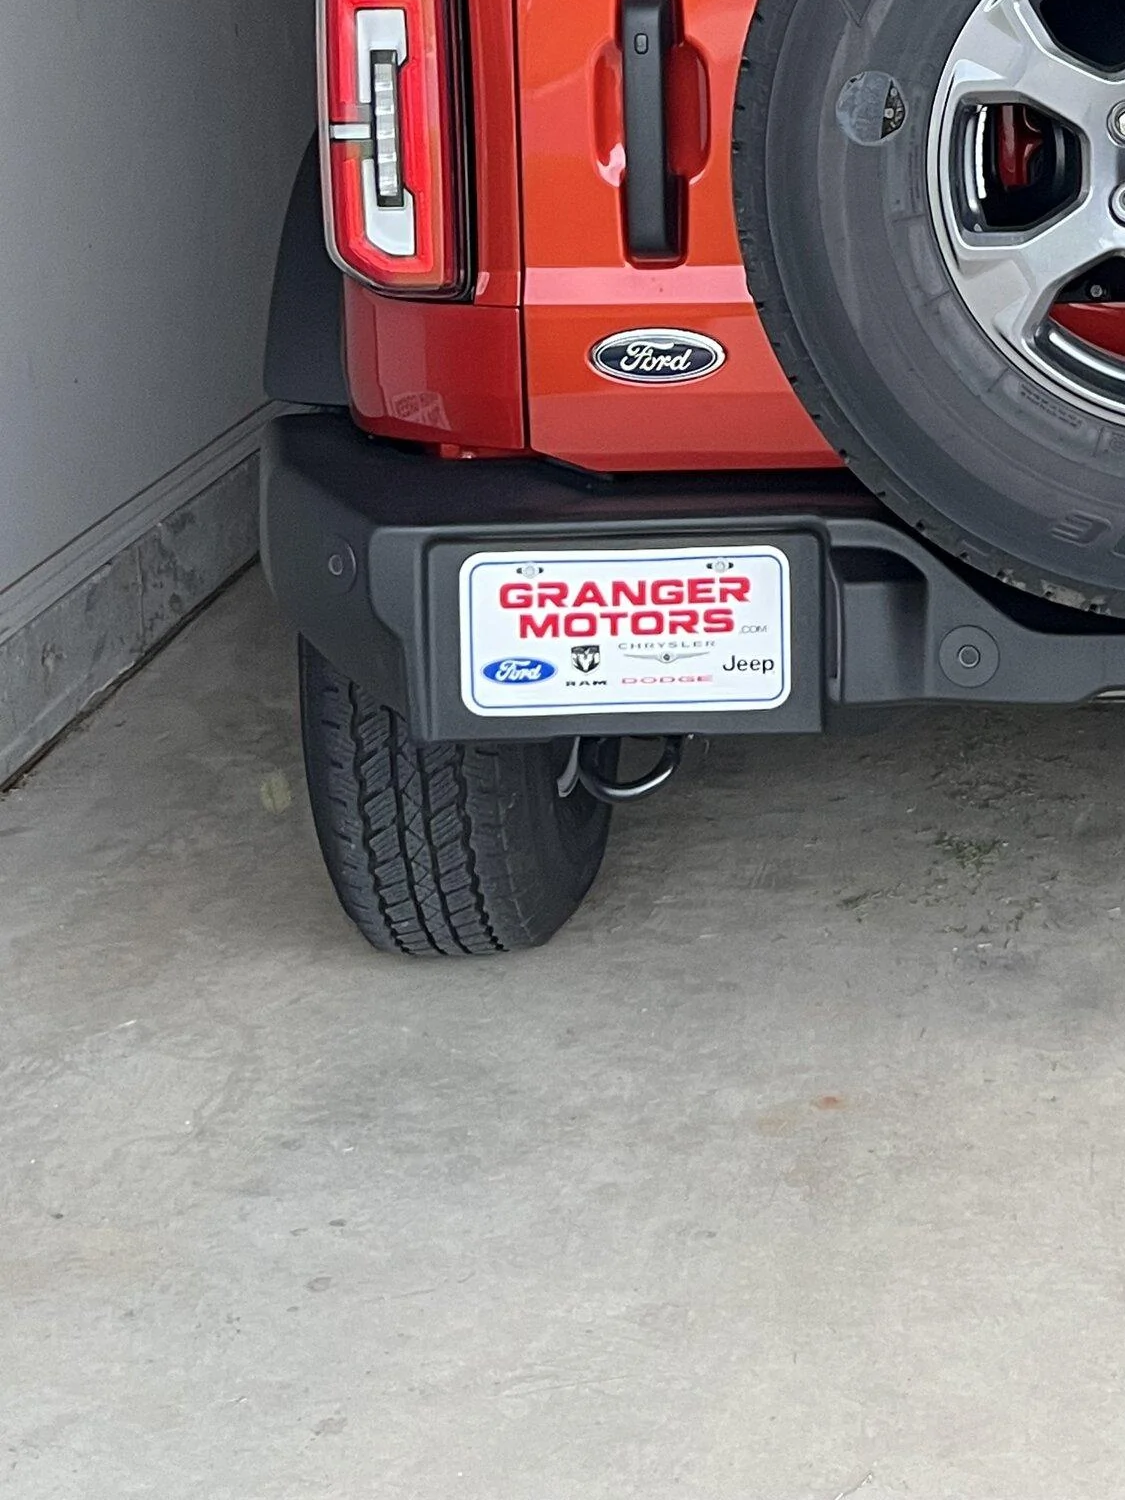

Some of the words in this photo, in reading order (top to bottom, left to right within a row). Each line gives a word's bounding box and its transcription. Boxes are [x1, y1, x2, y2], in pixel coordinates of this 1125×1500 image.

[619, 340, 692, 372] Ford
[499, 576, 752, 609] GRANGER
[518, 608, 735, 639] MOTORS
[618, 640, 716, 650] CHRYSLER
[495, 658, 543, 683] Ford
[722, 654, 775, 674] Jeep
[566, 679, 607, 687] RAM
[621, 674, 713, 684] DODGE
